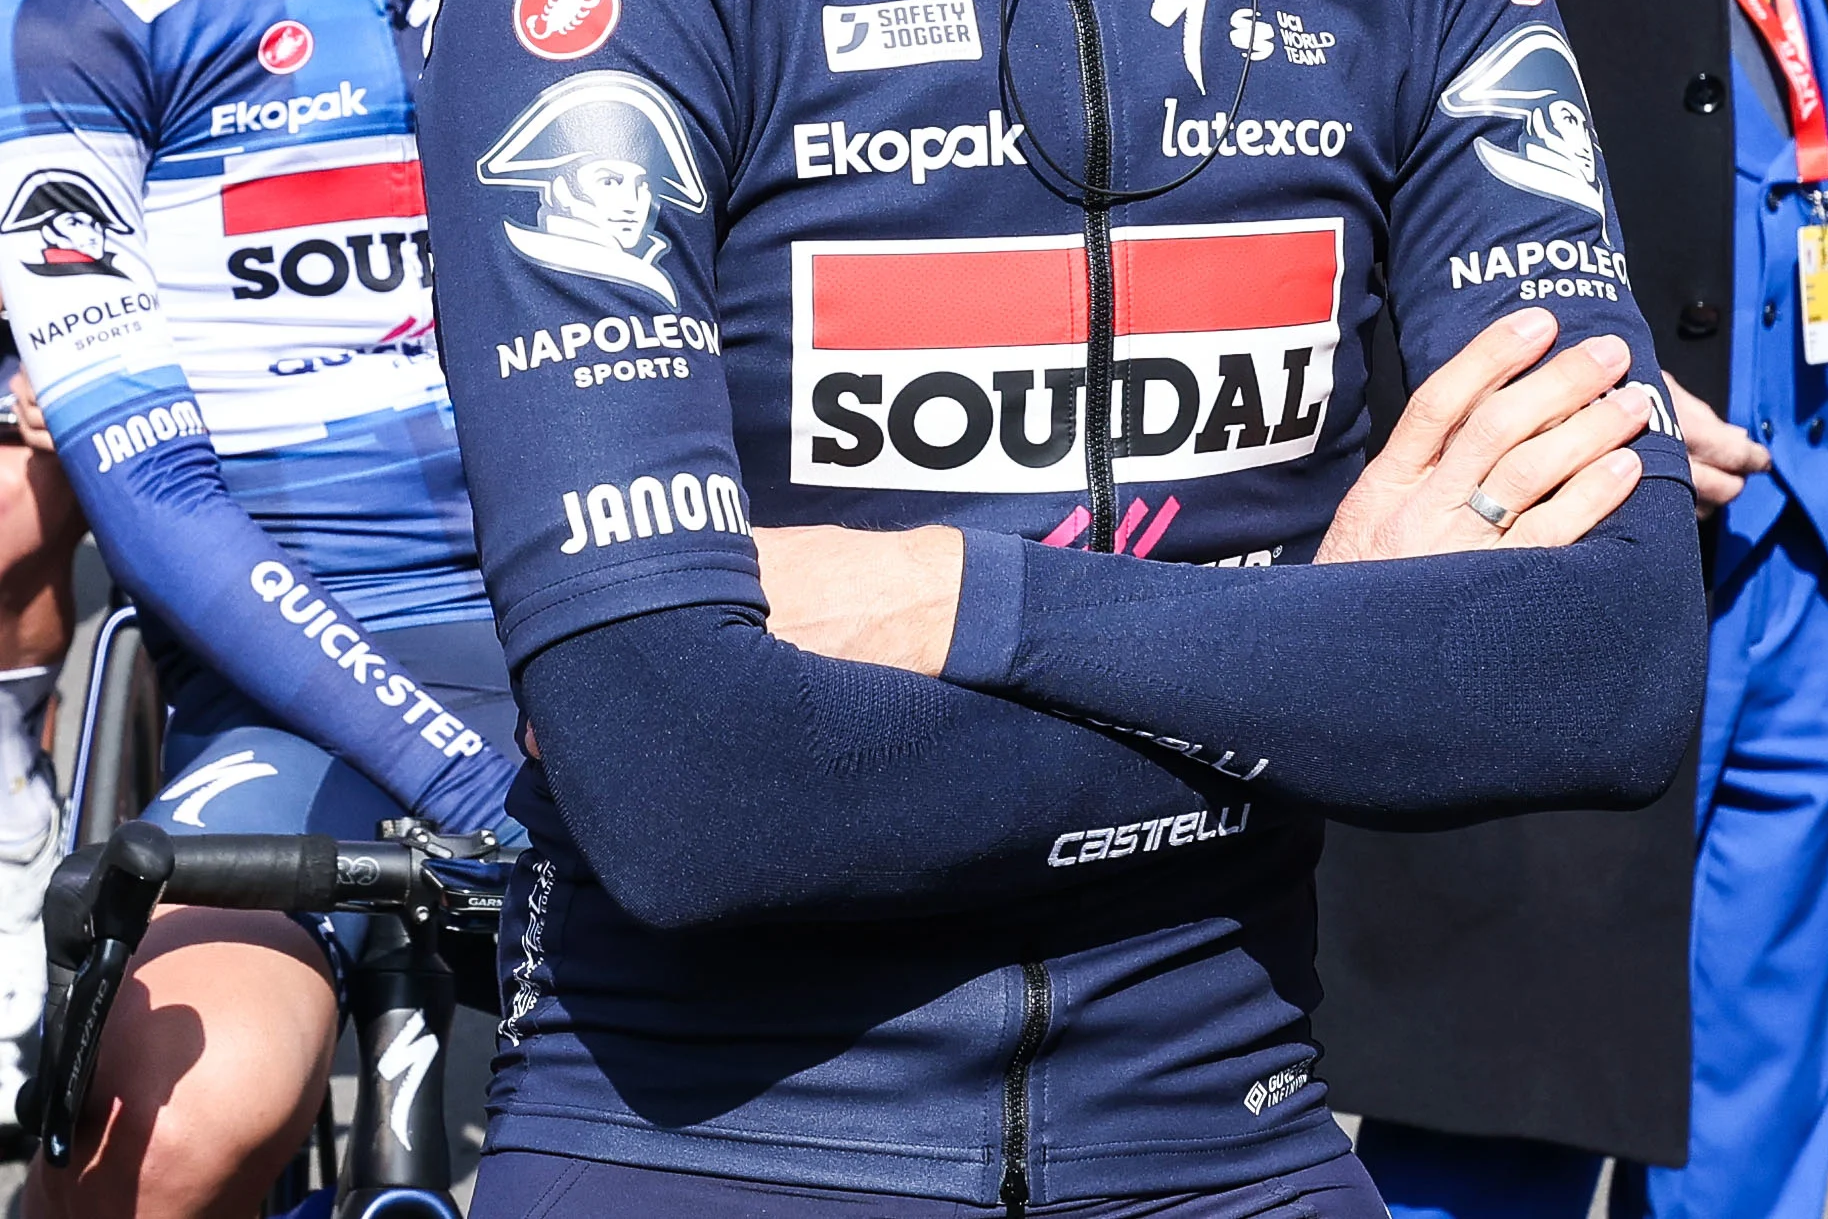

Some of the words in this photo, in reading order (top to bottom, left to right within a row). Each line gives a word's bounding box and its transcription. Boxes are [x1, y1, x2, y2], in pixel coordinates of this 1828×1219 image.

[877, 1, 966, 28] SAFETY
[1276, 10, 1304, 33] UCI
[881, 23, 972, 50] JOGGER
[1279, 28, 1336, 50] WORLD
[1283, 45, 1328, 66] TEAM
[210, 80, 369, 137] Ekopak
[1161, 97, 1347, 158] latexco
[793, 109, 1029, 185] Ekopak
[227, 230, 434, 300] SOU
[1449, 239, 1633, 290] NAPOLEO
[1519, 278, 1619, 302] SPORTS
[74, 320, 143, 352] SPORTS
[496, 313, 721, 379] NAPOLEON
[573, 357, 690, 389] SPORTS
[811, 346, 1323, 470] SOUDAL
